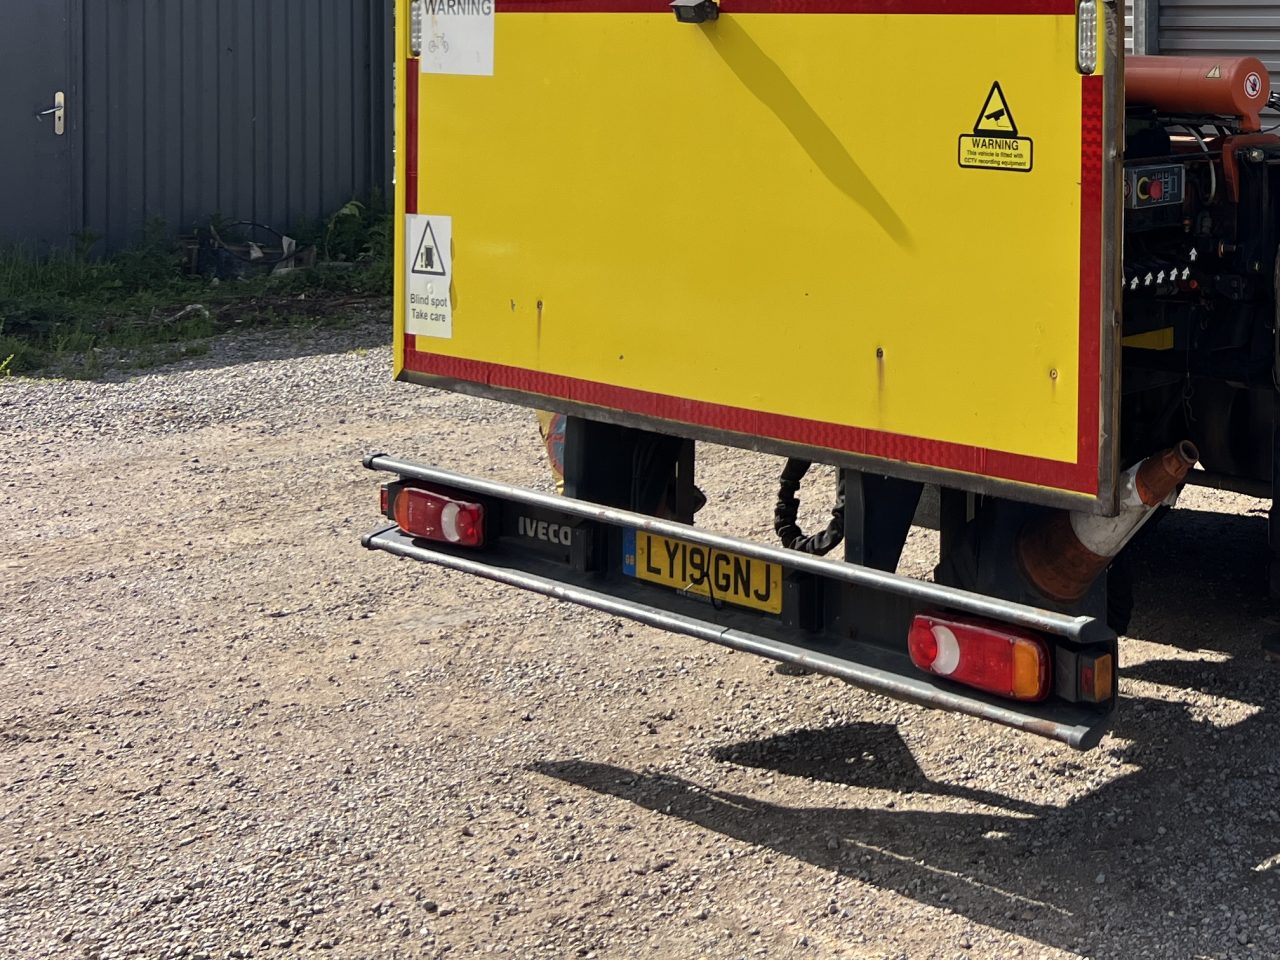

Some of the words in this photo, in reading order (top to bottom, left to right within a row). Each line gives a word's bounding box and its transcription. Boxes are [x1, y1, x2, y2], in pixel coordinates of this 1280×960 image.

[971, 138, 1019, 151] WARNING
[410, 293, 430, 305] Blind
[431, 297, 447, 308] spot
[412, 308, 428, 320] Take
[430, 312, 446, 322] care
[518, 516, 572, 546] IVECO
